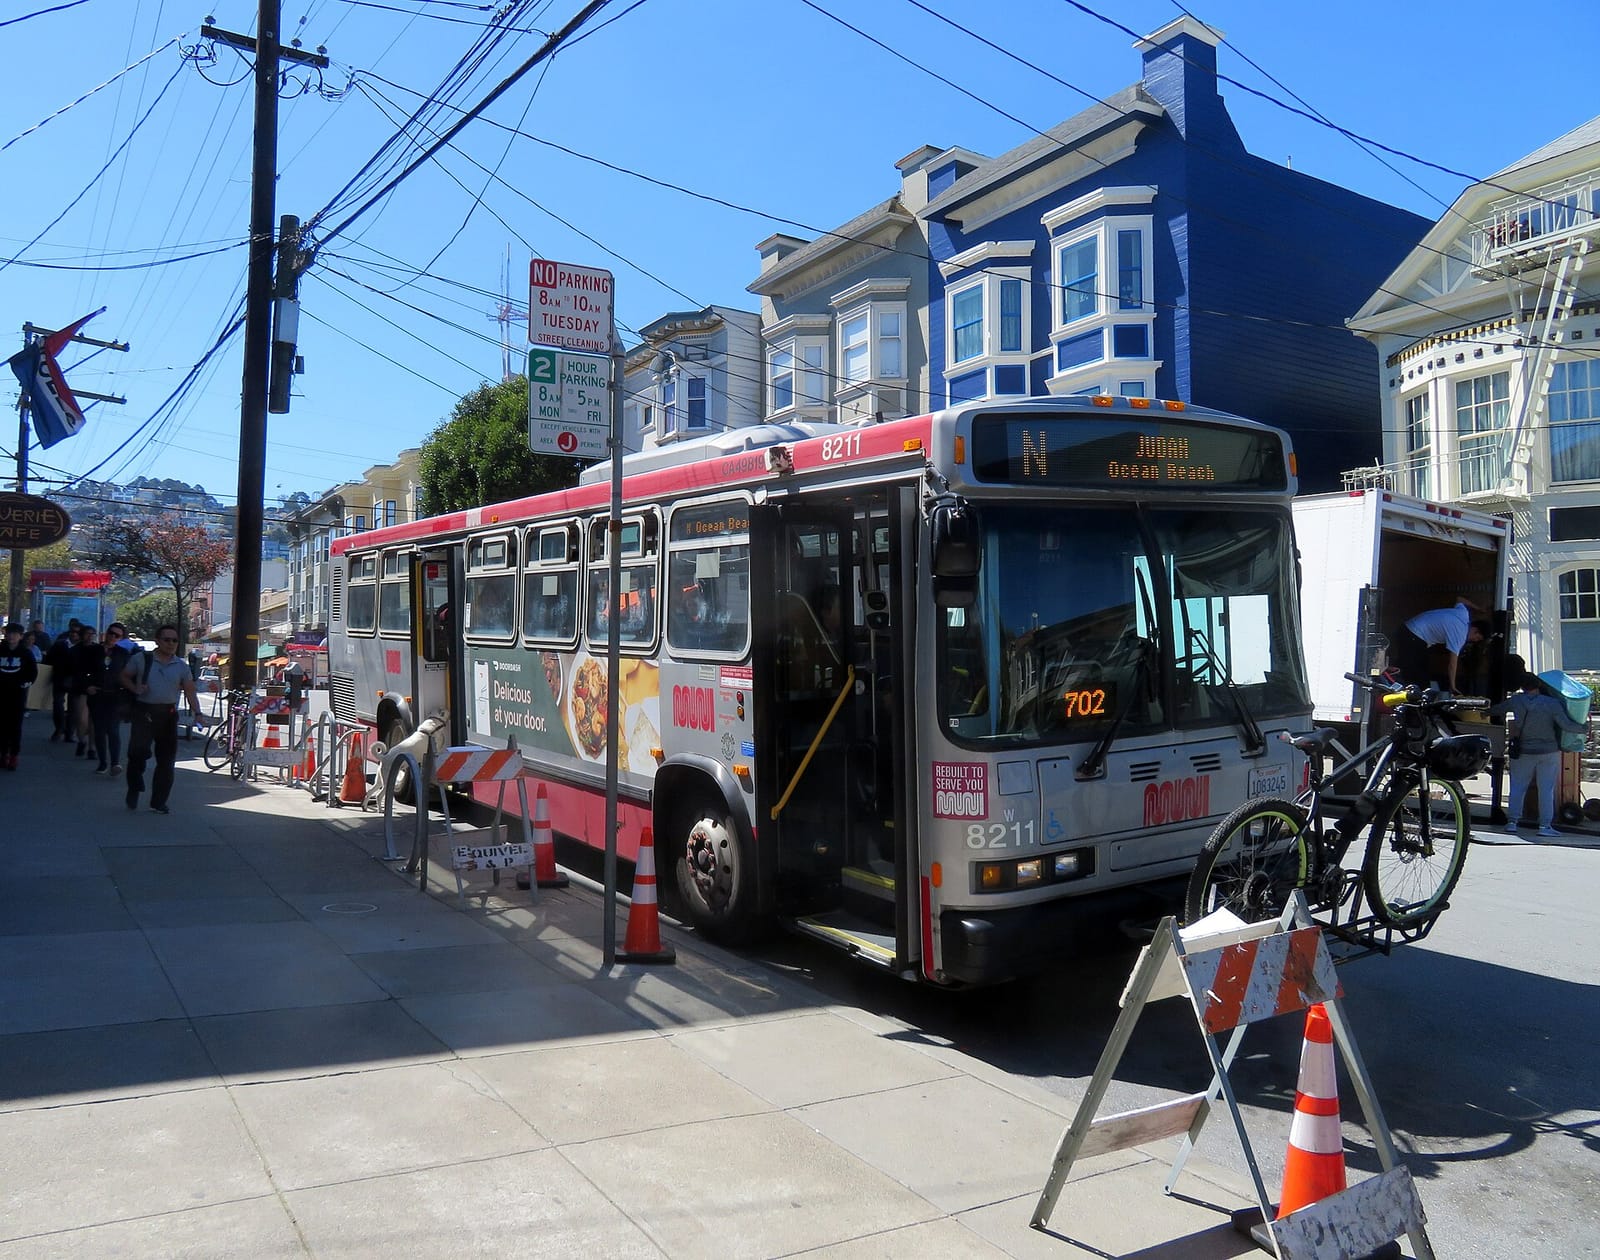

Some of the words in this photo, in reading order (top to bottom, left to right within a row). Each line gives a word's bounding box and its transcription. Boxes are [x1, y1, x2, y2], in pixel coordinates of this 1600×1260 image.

[533, 262, 555, 285] NO
[559, 271, 609, 294] PARKING
[542, 312, 600, 334] TUESDAY
[537, 333, 565, 345] STREET
[566, 337, 605, 350] CLEANING
[534, 356, 551, 378] 2
[567, 360, 598, 374] HOUR
[560, 373, 606, 389] PARKING
[539, 405, 560, 418] MON
[587, 410, 601, 422] FRI
[540, 422, 560, 430] EXCEPT
[562, 424, 587, 433] VEHICLES
[560, 434, 573, 450] J
[822, 432, 862, 462] 8211
[1022, 429, 1047, 477] N
[1135, 435, 1189, 459] JUDAH
[1107, 460, 1160, 481] Ocean
[1166, 463, 1215, 481] Beach
[695, 521, 725, 533] Ocean
[493, 679, 532, 705] Delicious
[1063, 688, 1106, 718] 702
[494, 706, 503, 723] at
[503, 710, 522, 729] your
[523, 709, 547, 733] door.
[935, 765, 969, 778] REBUILT
[971, 766, 984, 778] TO
[935, 778, 962, 791] SERVE
[965, 779, 984, 791] YOU
[1251, 775, 1286, 796] 1083245
[1003, 808, 1015, 823] W
[966, 819, 1034, 849] 8211
